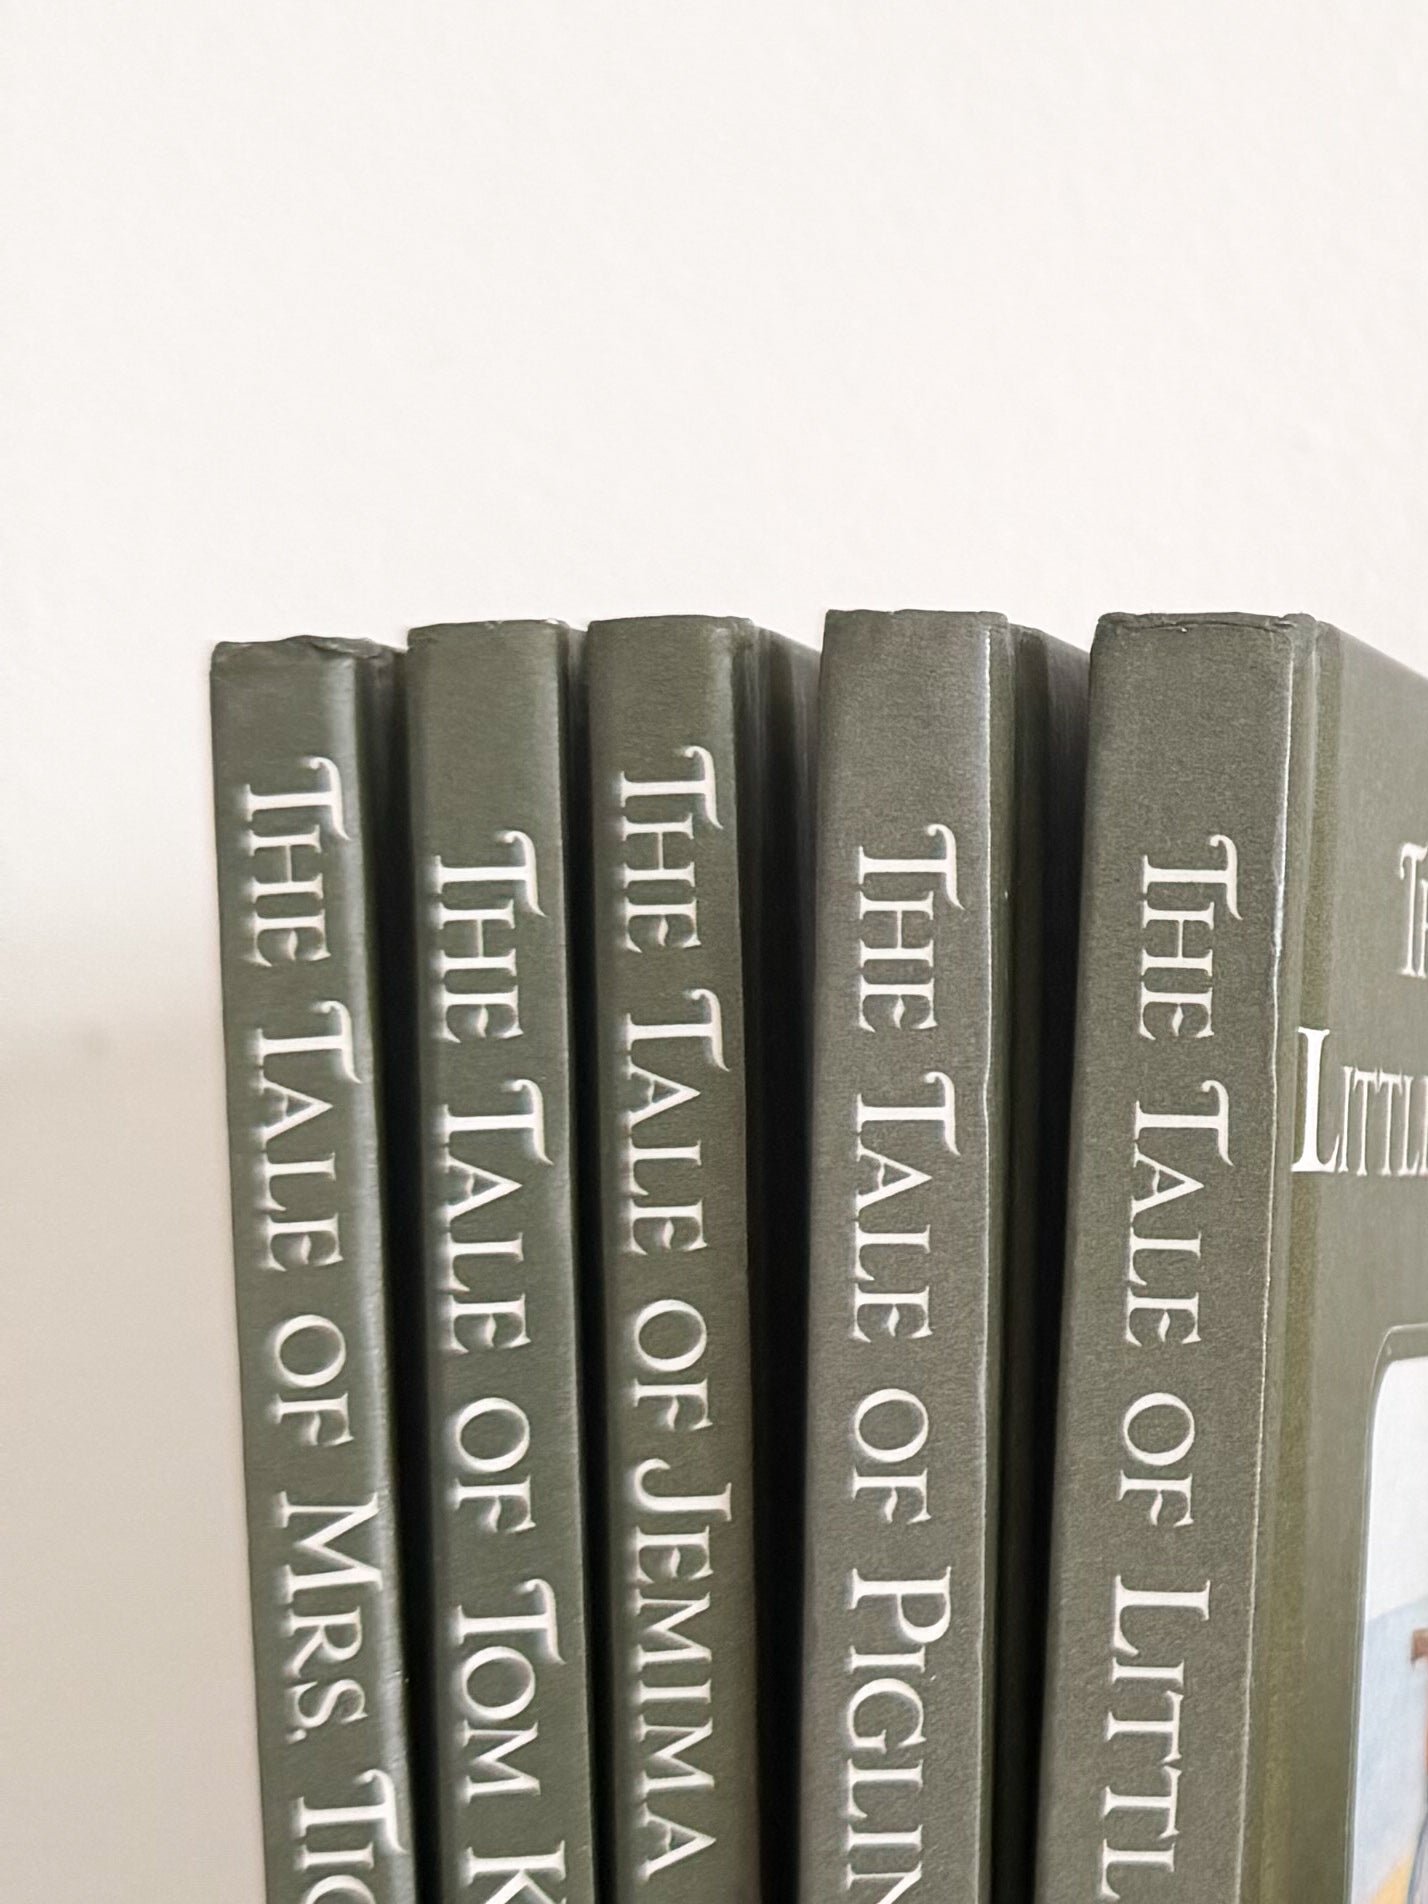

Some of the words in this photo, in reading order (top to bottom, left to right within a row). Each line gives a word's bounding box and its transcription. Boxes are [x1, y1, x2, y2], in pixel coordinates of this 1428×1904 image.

[240, 755, 350, 969] THE
[432, 831, 544, 1043] THE
[617, 746, 722, 952] THE
[857, 824, 963, 1032] THE
[1138, 834, 1242, 1040] THE
[251, 999, 361, 1273] TALE
[439, 1079, 551, 1353] TALE
[623, 989, 728, 1255] TALE
[851, 1072, 960, 1342] TALE
[1125, 1080, 1233, 1346] TALE
[270, 1314, 354, 1447] OF
[450, 1398, 535, 1532] OF
[630, 1299, 712, 1430] OF
[850, 1389, 931, 1523] OF
[1118, 1393, 1195, 1526] OF
[278, 1489, 384, 1744] MRS.
[452, 1579, 562, 1802] TOM
[630, 1459, 731, 1879] JEMIMA
